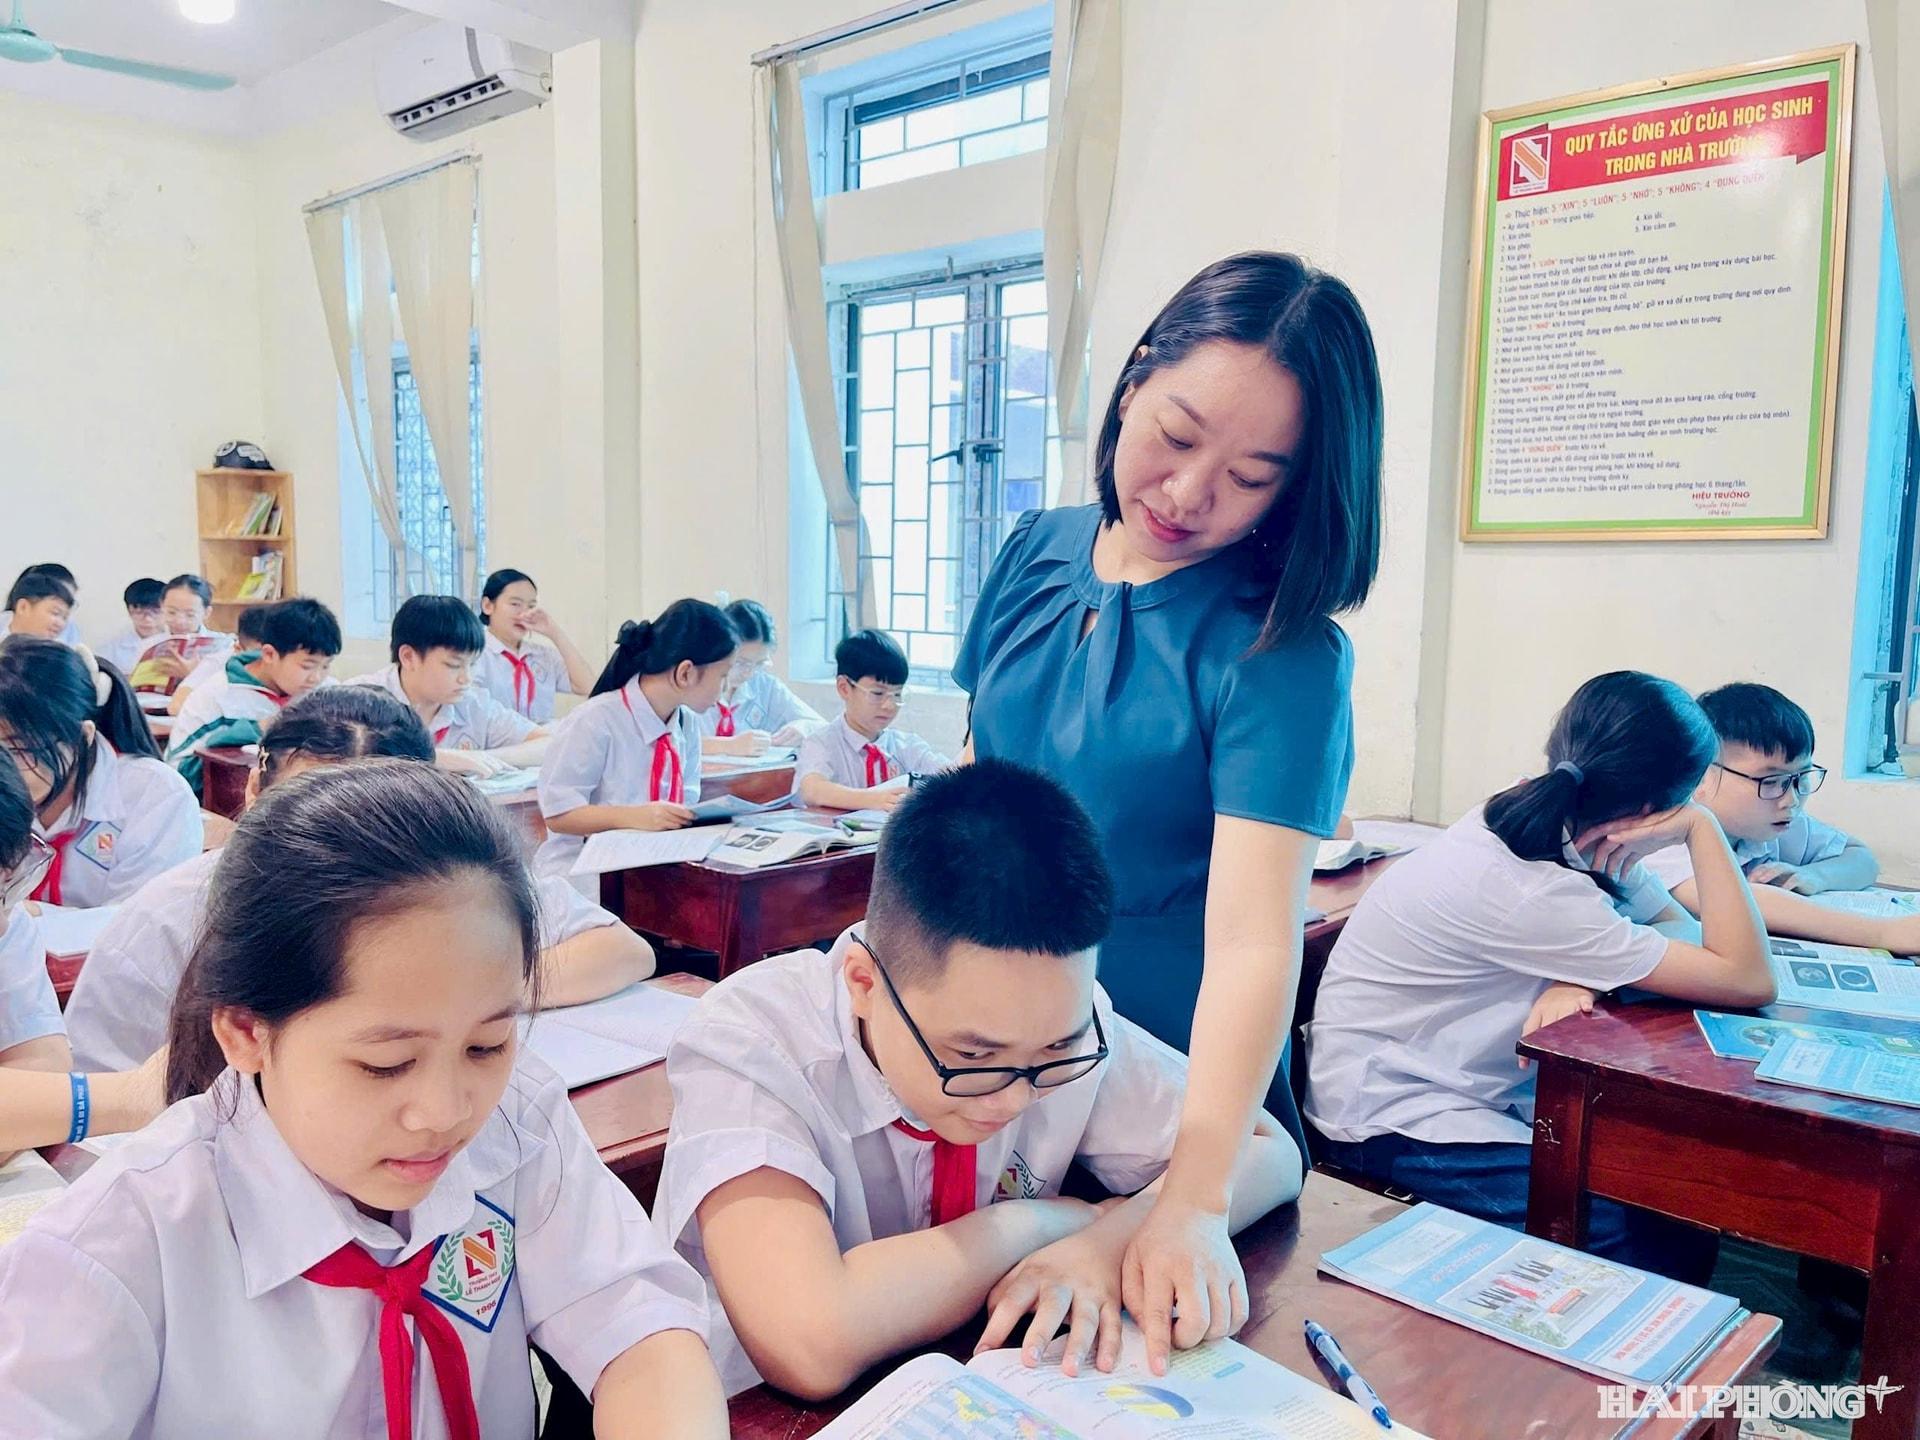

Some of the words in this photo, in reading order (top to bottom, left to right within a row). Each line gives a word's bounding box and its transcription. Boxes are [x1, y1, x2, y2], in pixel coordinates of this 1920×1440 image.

[1565, 134, 1594, 157] QUY
[1599, 123, 1629, 147] TẮC
[1632, 121, 1666, 144] ỨNG
[1669, 112, 1696, 138] XỬ
[1695, 105, 1730, 132] CỦA
[1733, 102, 1768, 129] HỌC
[1771, 96, 1813, 120] SINH
[1605, 153, 1656, 177] TRONG
[1659, 142, 1695, 168] NHÀ
[1692, 491, 1711, 500] HIỆU
[1714, 490, 1750, 499] TRƯỞNG
[475, 1300, 497, 1316] 1996
